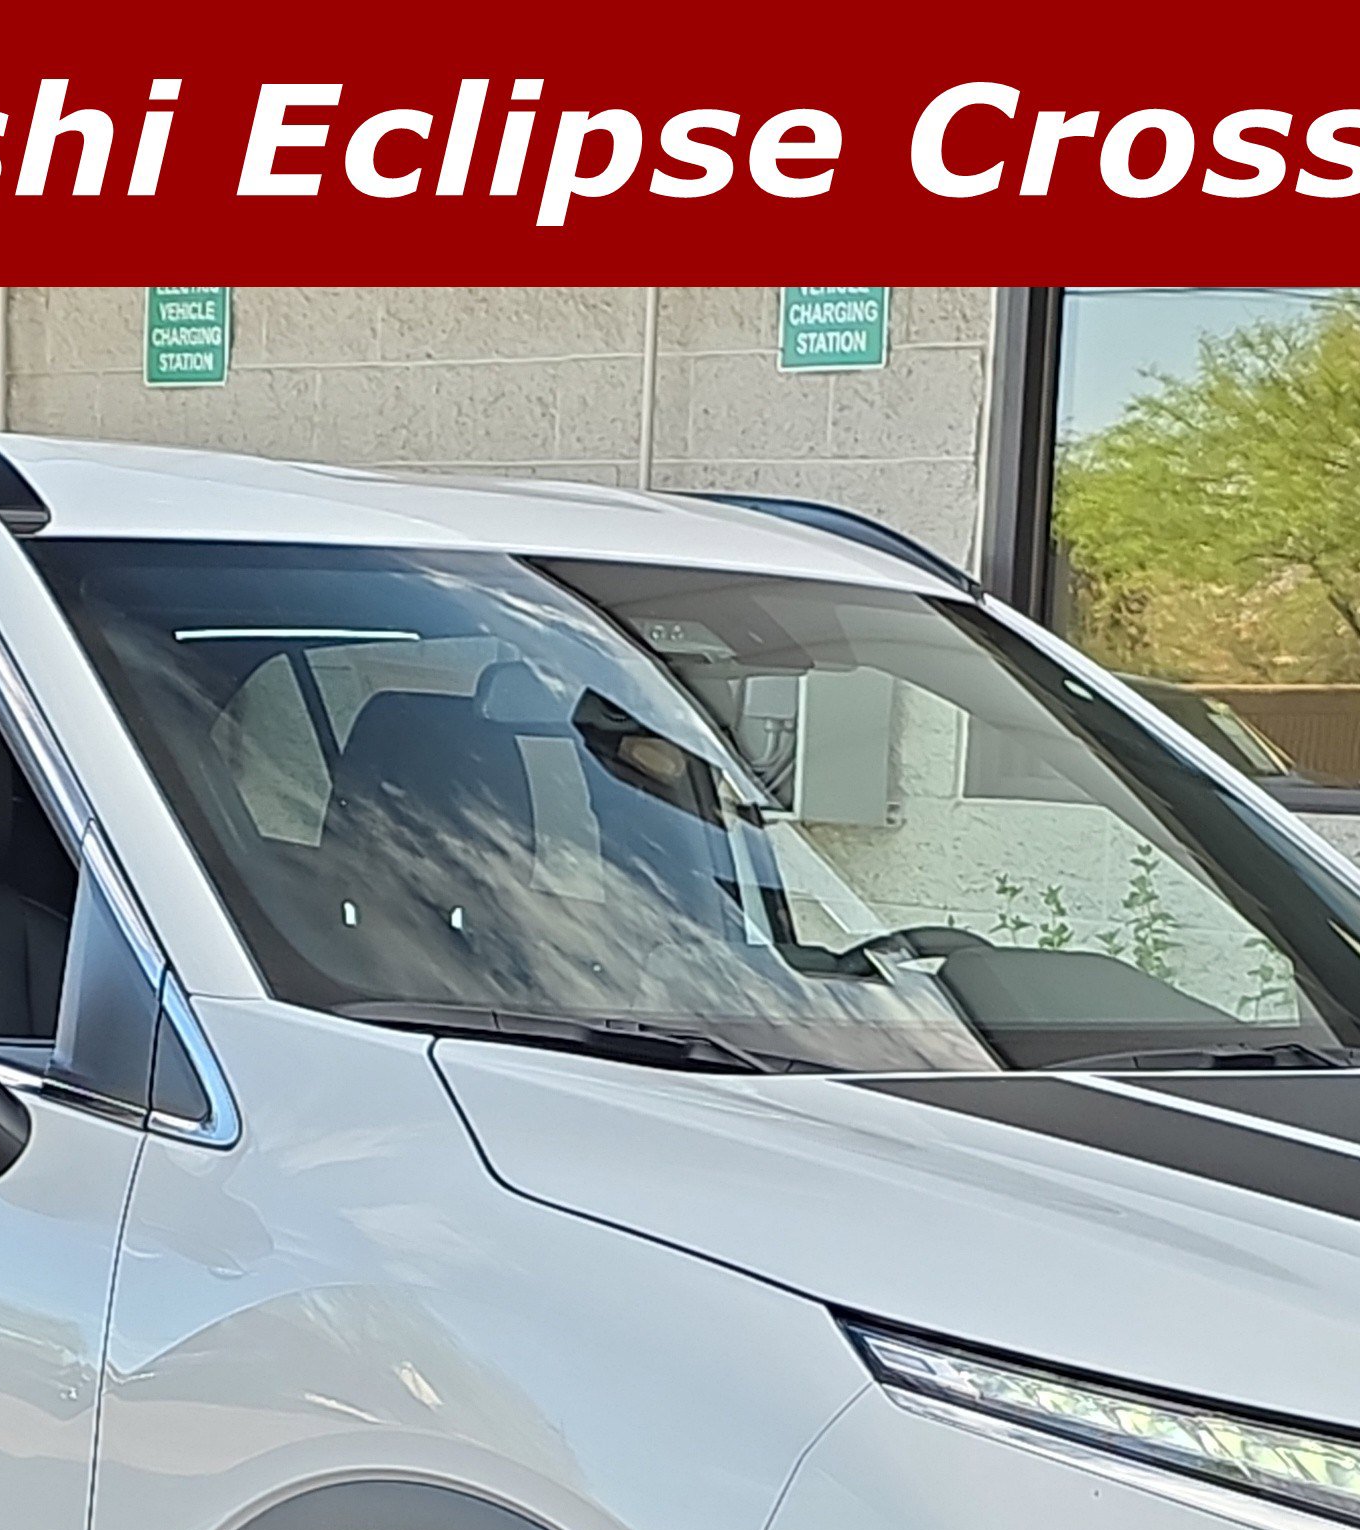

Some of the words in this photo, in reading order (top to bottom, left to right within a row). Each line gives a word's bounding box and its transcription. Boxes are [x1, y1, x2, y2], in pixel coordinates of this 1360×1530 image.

[159, 300, 216, 321] VEHICLE
[789, 300, 879, 326] CHARGING
[152, 326, 222, 347] CHARGING
[796, 330, 867, 355] STATION
[159, 352, 214, 372] STATION
